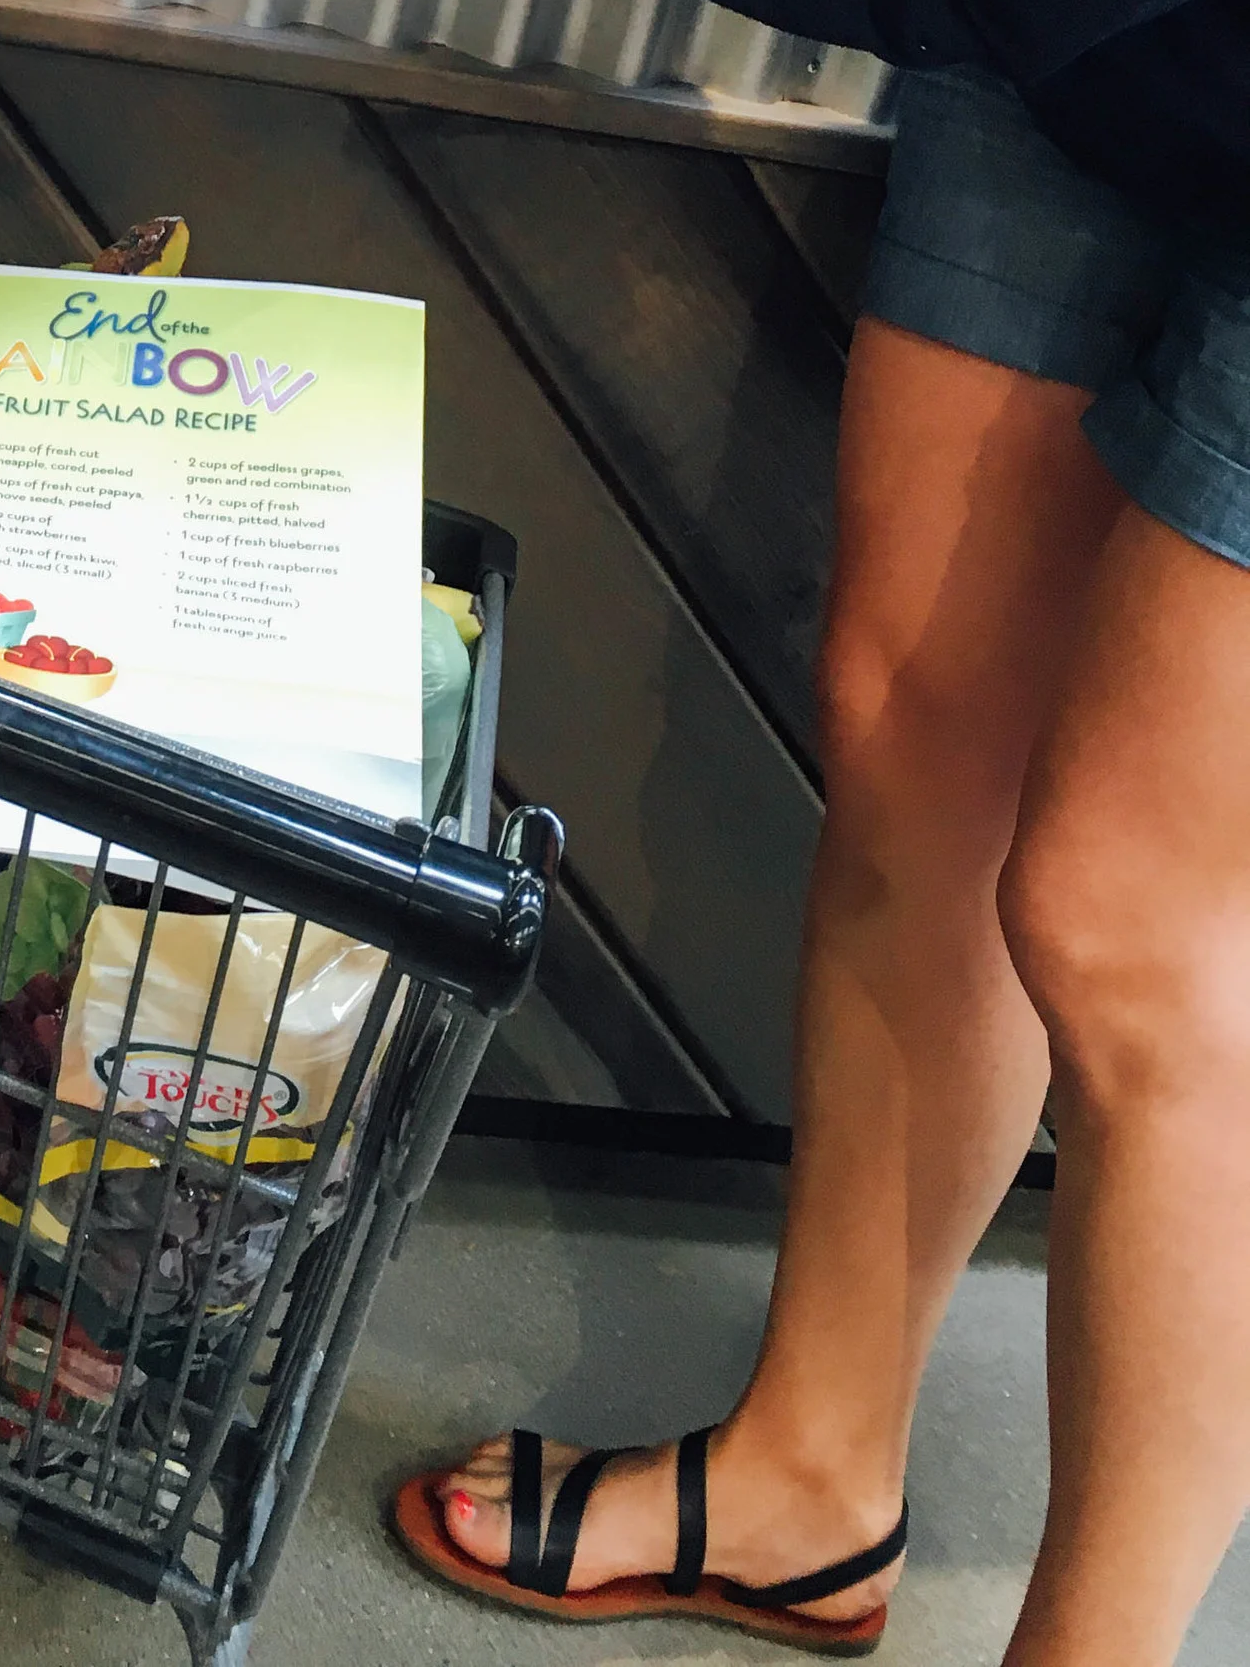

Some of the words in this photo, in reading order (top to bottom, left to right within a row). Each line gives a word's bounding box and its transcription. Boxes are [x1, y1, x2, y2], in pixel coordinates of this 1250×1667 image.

[49, 289, 167, 343] End
[76, 400, 164, 426] SALAD
[175, 408, 258, 432] RECIPE
[29, 444, 43, 455] of
[45, 444, 76, 457] fresh
[79, 449, 100, 459] cut
[91, 465, 134, 477] peeled
[188, 457, 196, 467] 2
[199, 460, 227, 471] cups
[230, 461, 245, 473] of
[248, 463, 297, 474] seedless
[24, 479, 38, 490] of
[41, 480, 72, 492] fresh
[75, 484, 95, 494] cut
[186, 475, 222, 485] green
[225, 476, 247, 486] and
[250, 478, 271, 488] red
[274, 479, 352, 494] combination
[69, 498, 112, 510] peeled
[218, 498, 247, 509] cups
[250, 500, 265, 512] of
[267, 499, 299, 512] fresh
[7, 512, 35, 524] cups
[38, 515, 53, 527] of
[284, 517, 325, 529] halved
[9, 526, 87, 542] strawberries
[190, 534, 214, 544] cup
[217, 534, 231, 546] of
[234, 536, 266, 547] fresh
[269, 538, 341, 553] blueberries
[5, 545, 34, 556] cups
[37, 546, 51, 558] of
[54, 549, 86, 562] fresh
[17, 560, 52, 571] sliced
[188, 554, 211, 565] cup
[215, 555, 230, 567] of
[232, 557, 264, 569] fresh
[268, 561, 338, 575] raspberries
[177, 571, 185, 580] 2
[188, 574, 218, 585] cups
[221, 577, 256, 589] sliced
[259, 581, 292, 593] fresh
[176, 585, 219, 599] banana
[184, 607, 255, 624] tablespoon
[258, 616, 272, 628] of
[172, 618, 205, 630] fresh
[209, 624, 253, 638] orange
[255, 631, 287, 642] juice
